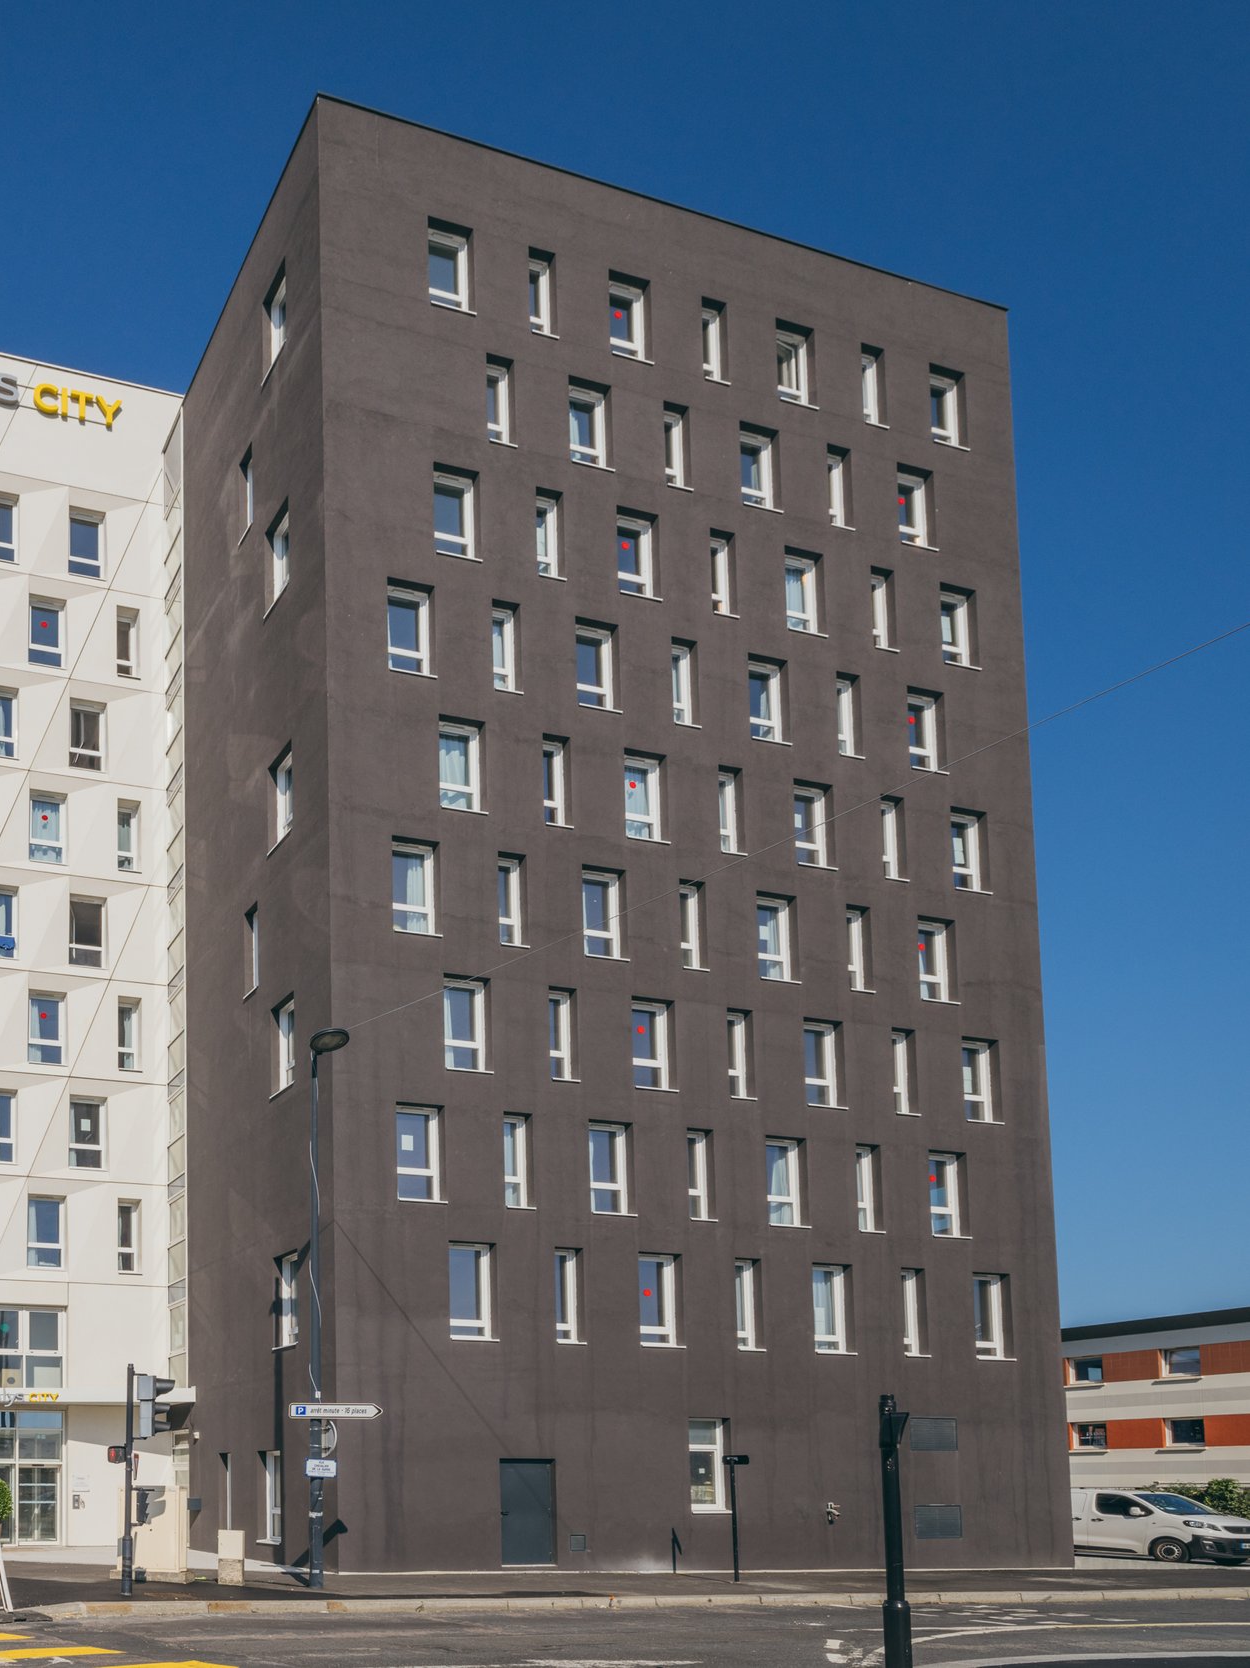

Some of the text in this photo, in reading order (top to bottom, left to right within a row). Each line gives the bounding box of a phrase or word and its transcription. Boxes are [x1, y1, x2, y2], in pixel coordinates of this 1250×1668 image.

[33, 383, 122, 428] CITY
[29, 1392, 59, 1402] CITY
[351, 1407, 367, 1415] places
